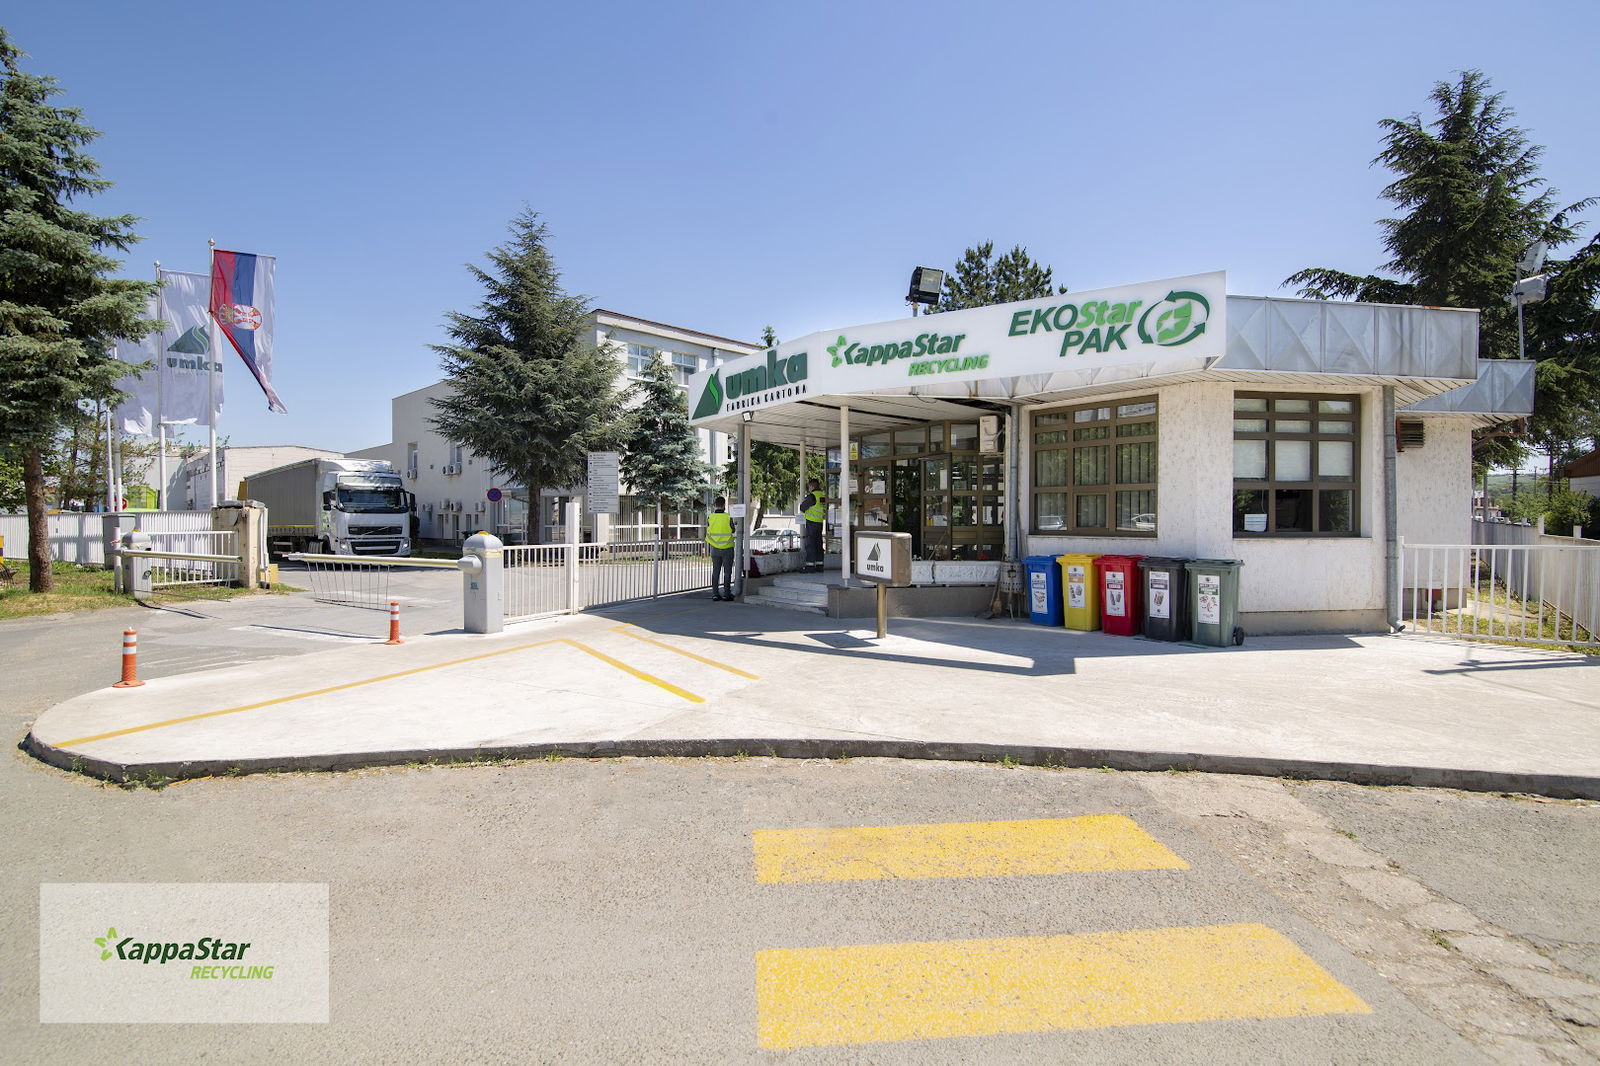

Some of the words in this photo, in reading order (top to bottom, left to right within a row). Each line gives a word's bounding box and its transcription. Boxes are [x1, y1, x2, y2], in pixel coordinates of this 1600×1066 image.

[1008, 300, 1143, 337] EKOStar
[843, 333, 967, 366] KappaStar
[1059, 323, 1132, 357] PAK
[166, 356, 223, 373] umka
[725, 350, 808, 400] umka
[908, 354, 990, 376] RECYCLING
[726, 396, 761, 412] FABRIKA
[764, 384, 807, 403] KARTONA
[866, 562, 884, 572] umka
